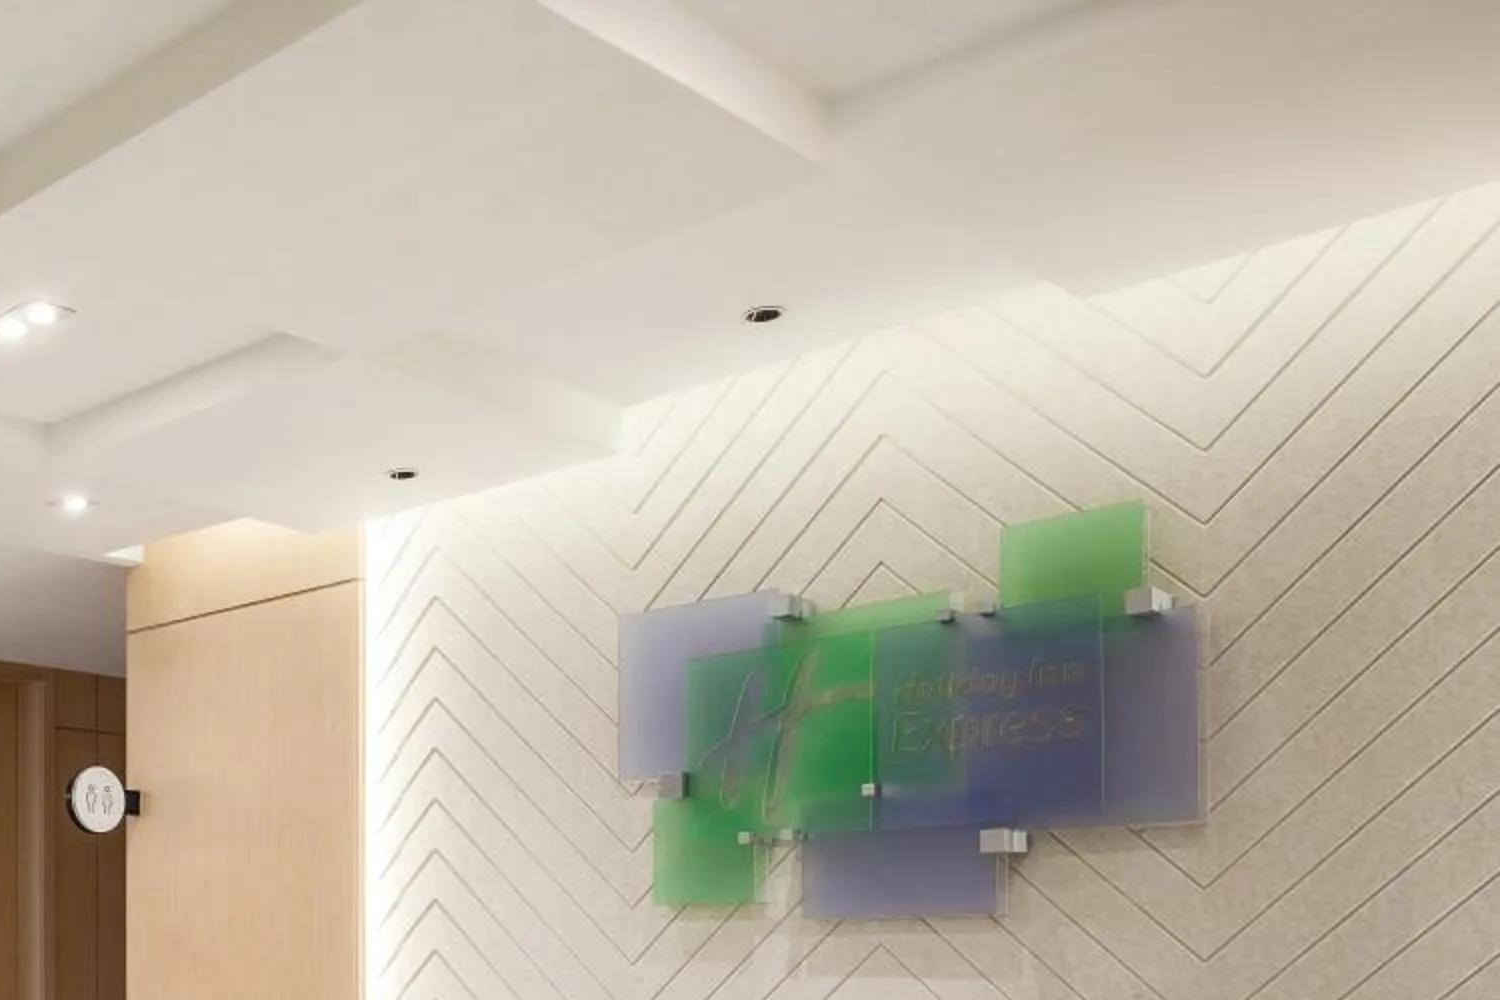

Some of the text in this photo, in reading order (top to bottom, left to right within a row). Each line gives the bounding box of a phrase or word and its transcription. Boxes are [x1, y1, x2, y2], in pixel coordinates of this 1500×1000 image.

[893, 656, 1087, 700] Holiday Inn
[891, 702, 1084, 760] Express
